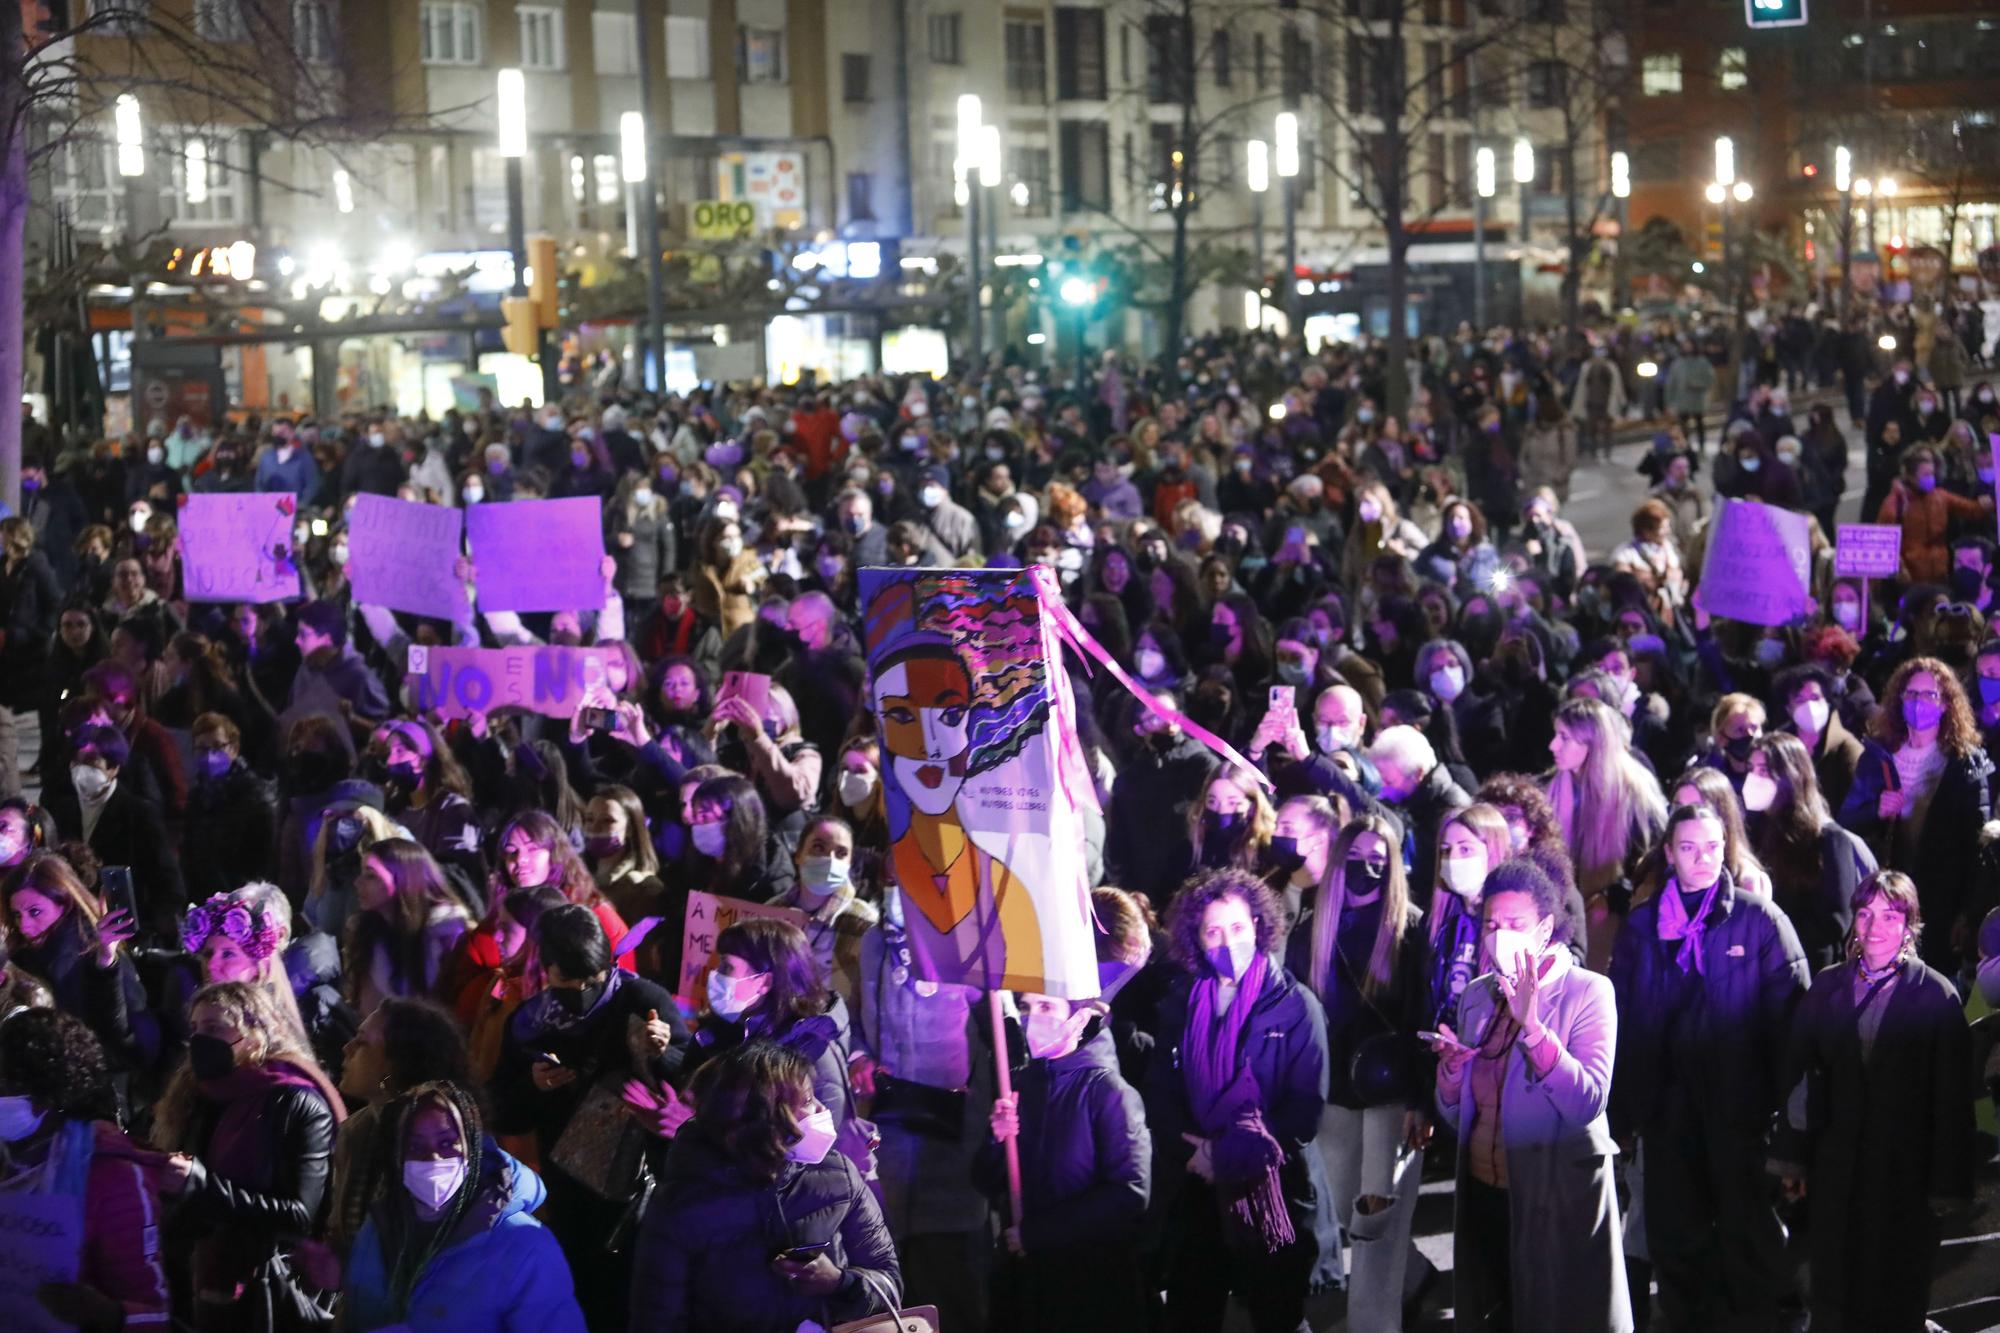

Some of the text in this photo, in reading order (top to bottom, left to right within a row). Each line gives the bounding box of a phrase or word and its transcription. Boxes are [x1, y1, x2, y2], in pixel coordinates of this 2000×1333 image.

[696, 201, 753, 228] ORO
[418, 660, 494, 712] NO
[690, 901, 705, 920] A
